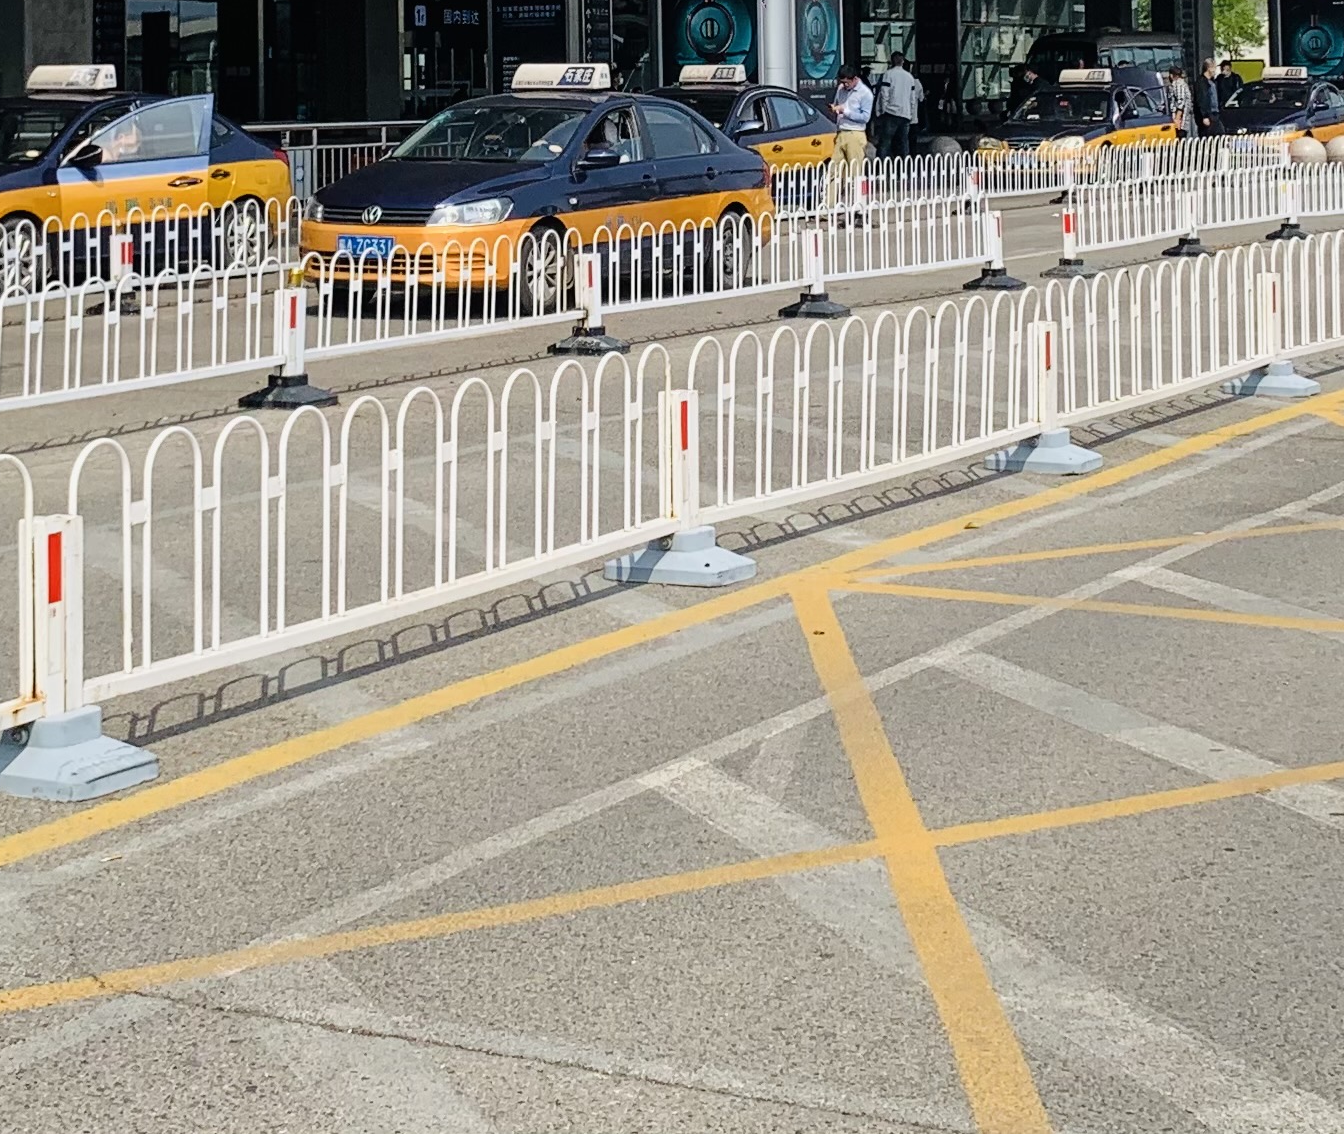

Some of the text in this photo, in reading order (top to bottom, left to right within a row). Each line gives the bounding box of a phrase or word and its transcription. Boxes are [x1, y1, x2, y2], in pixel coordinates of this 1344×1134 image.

[443, 9, 480, 25] 国内到达
[564, 68, 594, 84] 石家庄
